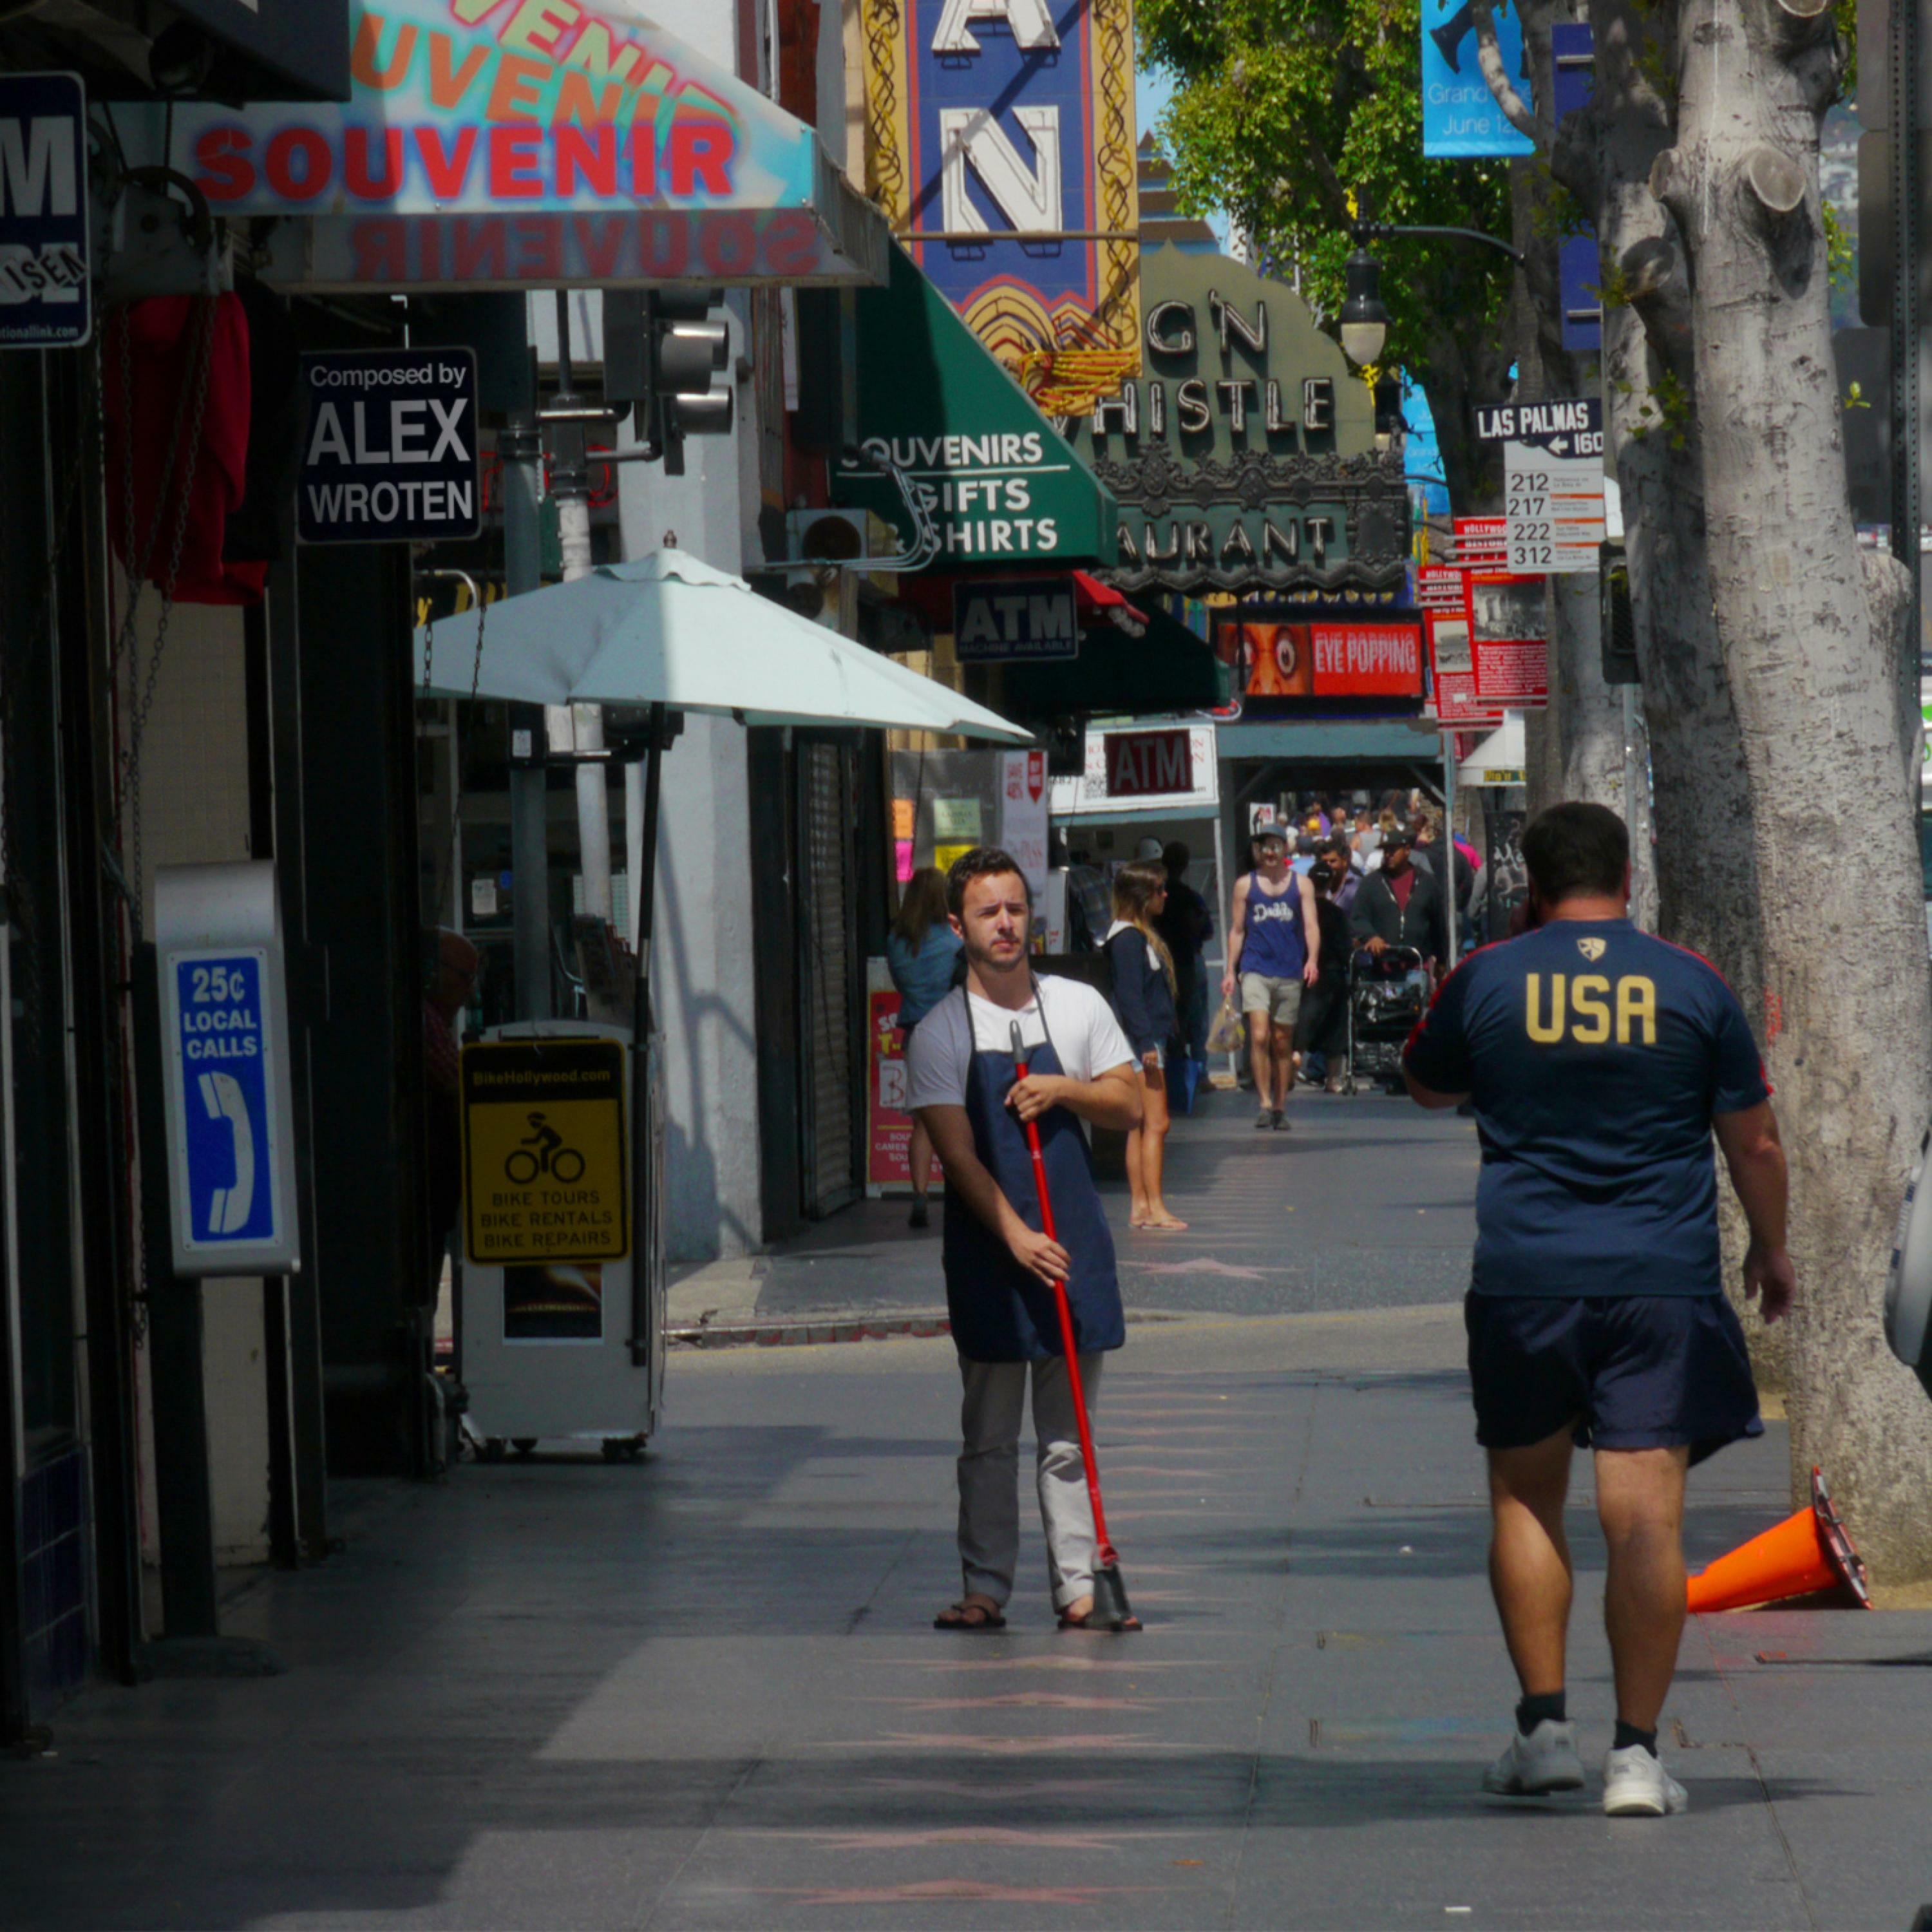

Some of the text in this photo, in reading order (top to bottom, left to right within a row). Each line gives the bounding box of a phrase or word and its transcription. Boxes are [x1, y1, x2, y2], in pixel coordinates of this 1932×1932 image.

[1428, 82, 1488, 104] Grand
[1443, 113, 1490, 135] June
[196, 126, 734, 201] SOUVENIR
[310, 362, 466, 391] Composed by
[306, 397, 471, 466] ALEX
[1478, 401, 1589, 439] LAS PALMAS
[1511, 473, 1549, 492] 212
[307, 479, 473, 524] WROTEN
[913, 478, 1030, 514] GIFTS
[1509, 498, 1545, 516] 217
[922, 518, 1058, 554] SHIRTS
[1514, 522, 1551, 542] 222
[1514, 546, 1551, 565] 312
[960, 593, 1074, 642] ATM
[1314, 632, 1418, 674] EYE POPPING
[1115, 735, 1186, 790] ATM
[193, 967, 245, 1003] 25¢
[184, 1009, 256, 1032] LOCAL
[1526, 973, 1656, 1044] USA
[187, 1036, 257, 1059] CALLS
[473, 1069, 611, 1086] BikeHollywood.com
[492, 1191, 600, 1207] BIKE TOURS
[481, 1210, 613, 1227] BIKE RENTALS
[484, 1231, 612, 1248] BIKE REPAIRS
